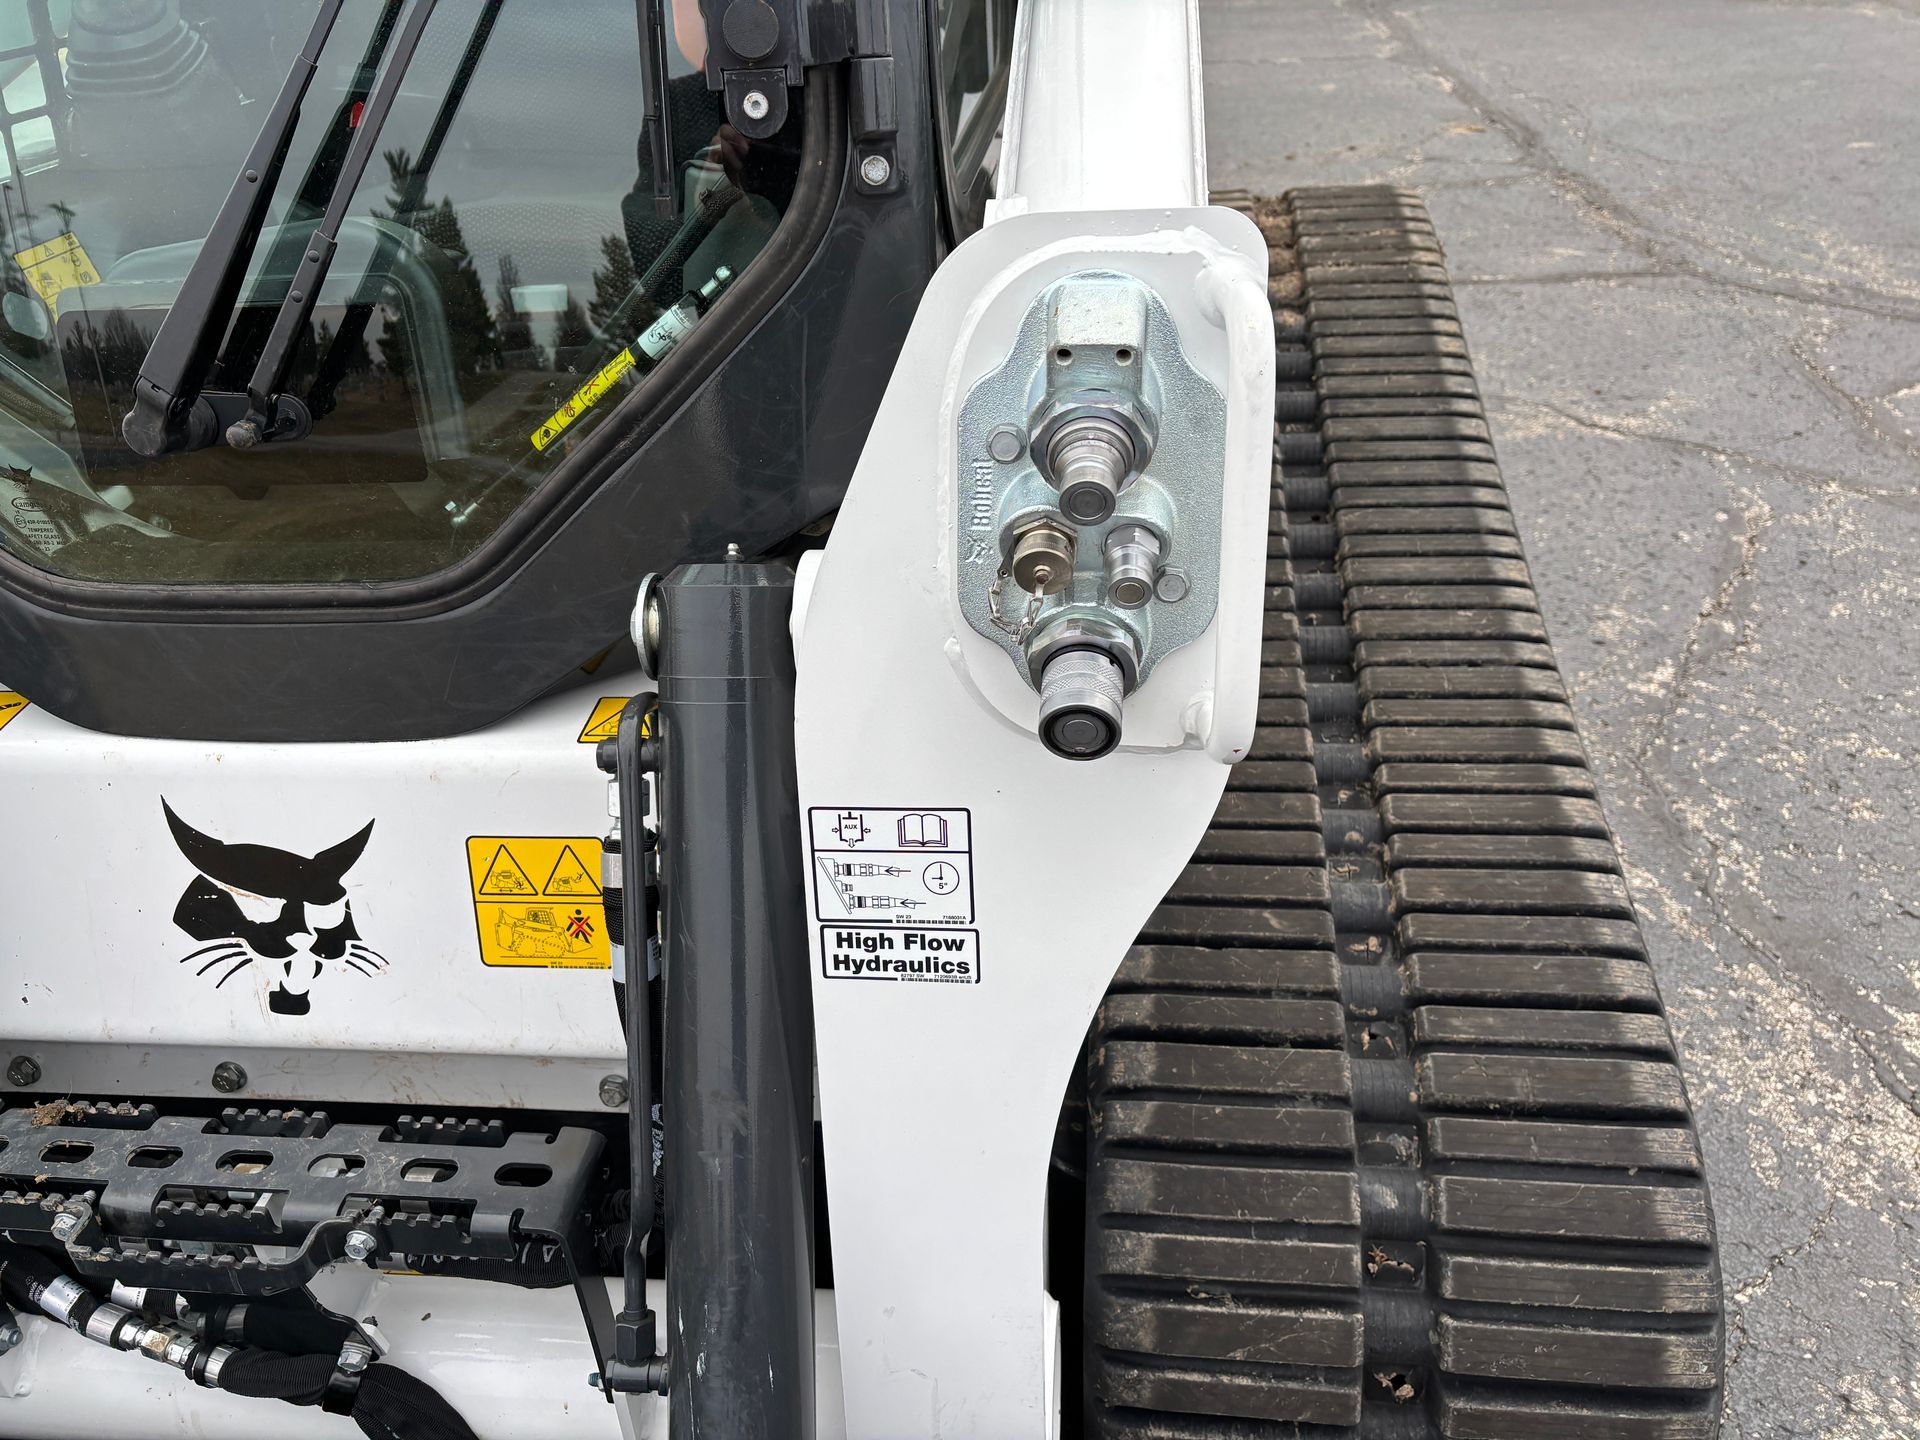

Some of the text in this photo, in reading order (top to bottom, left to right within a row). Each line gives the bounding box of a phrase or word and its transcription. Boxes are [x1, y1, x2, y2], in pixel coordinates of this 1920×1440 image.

[969, 459, 994, 530] Bobcat
[836, 931, 965, 952] High Flow
[833, 954, 970, 974] Hydraulics
